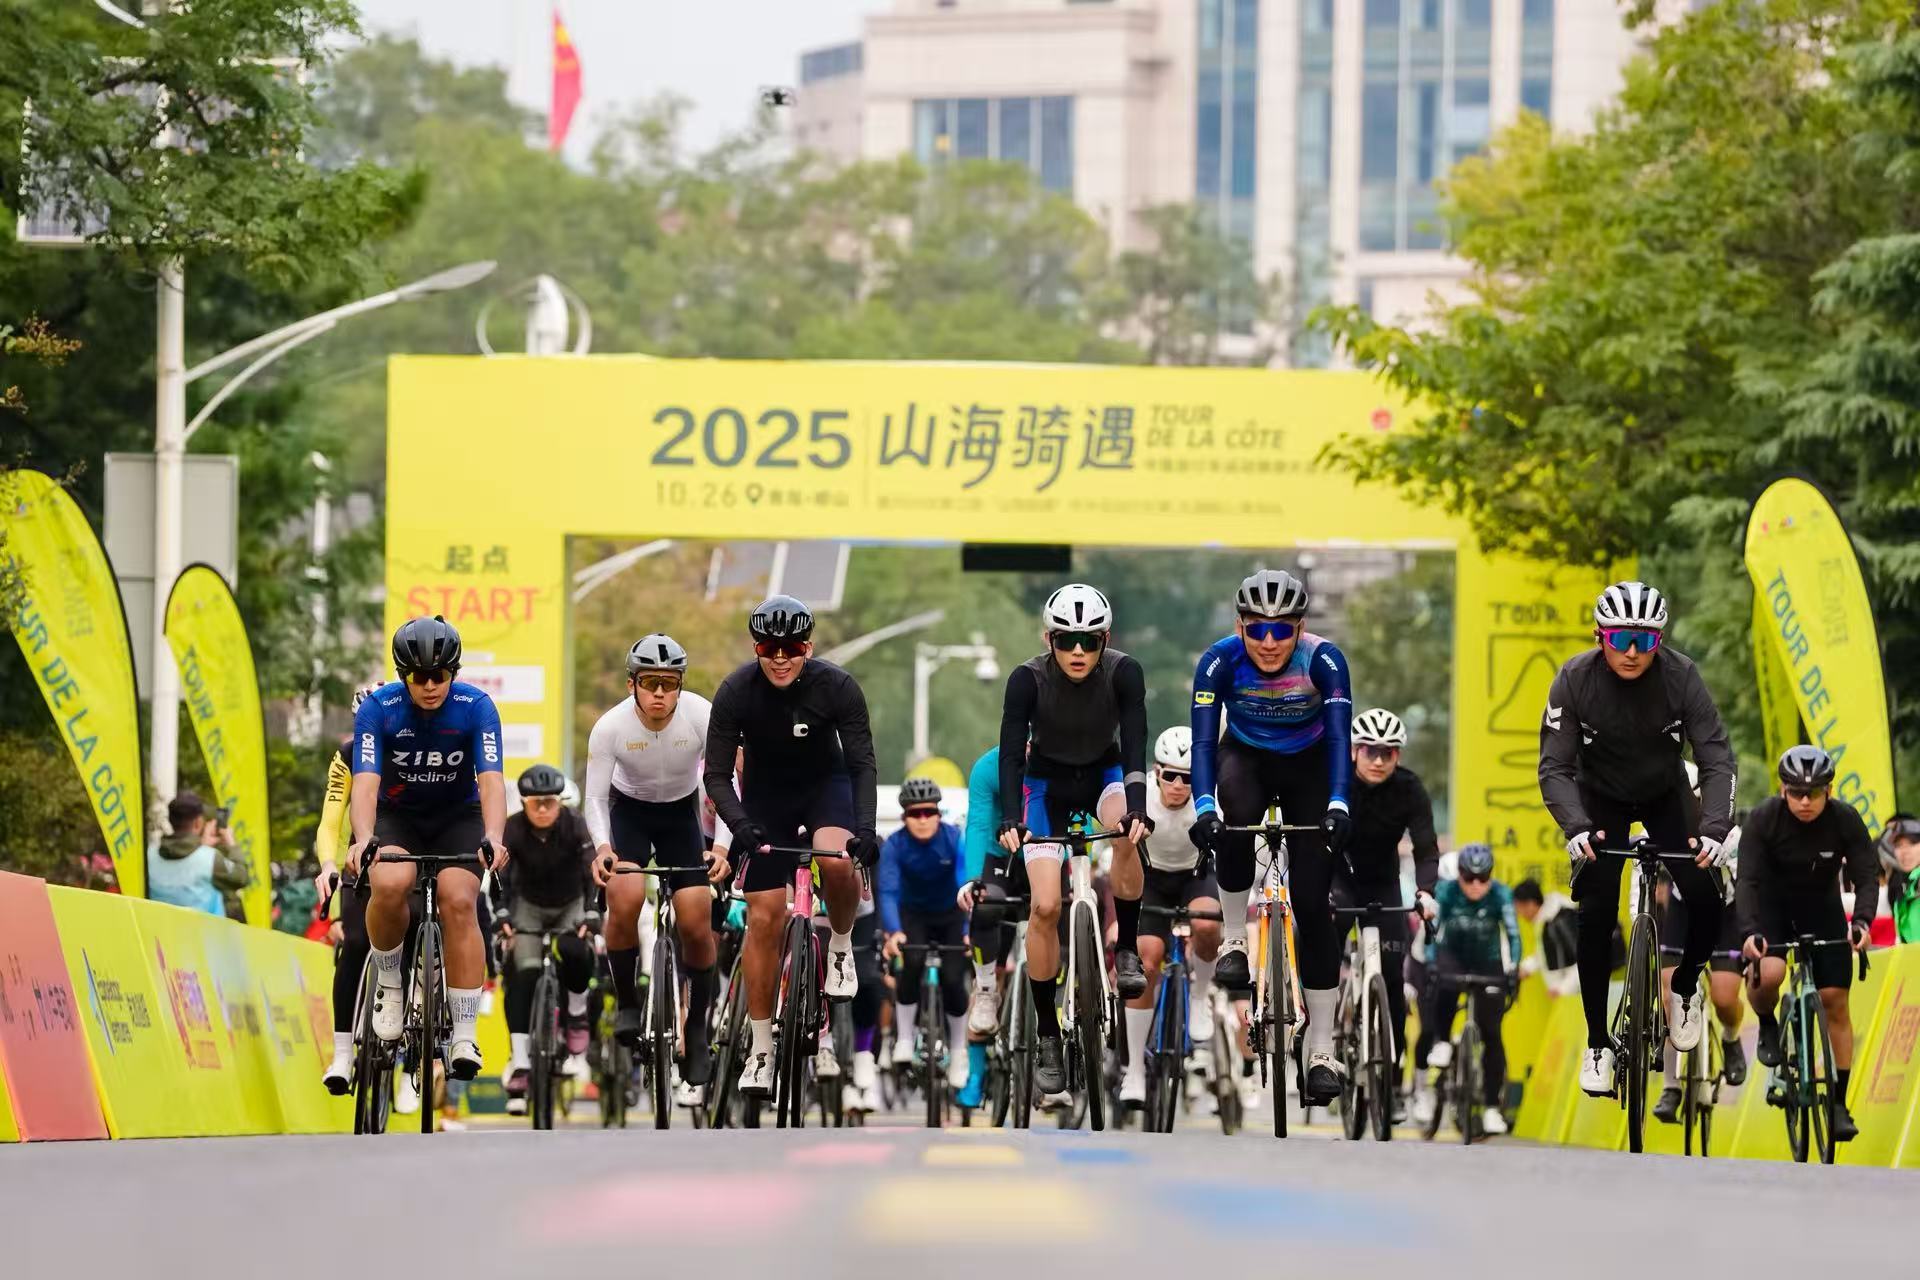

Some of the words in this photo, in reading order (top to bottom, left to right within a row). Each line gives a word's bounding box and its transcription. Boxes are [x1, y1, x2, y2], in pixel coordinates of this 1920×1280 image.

[1150, 404, 1215, 426] TOUR
[650, 407, 851, 469] 2025
[878, 401, 1134, 492] 山海骑遇
[1146, 428, 1174, 448] DE
[1186, 429, 1215, 449] LA
[1225, 419, 1284, 450] CÔTE
[655, 480, 738, 508] 10.26
[446, 544, 511, 574] 起点
[406, 585, 540, 623] START
[1579, 603, 1595, 625] D
[1766, 568, 1810, 666] TOUR
[1799, 665, 1832, 720] DE
[1837, 772, 1881, 834] CÔT
[41, 655, 81, 709] DE
[65, 708, 99, 763] LA
[90, 762, 135, 859] CÔTE
[361, 732, 375, 765] ZIBO
[391, 750, 464, 767] ZIBO
[482, 731, 498, 763] ZIBO
